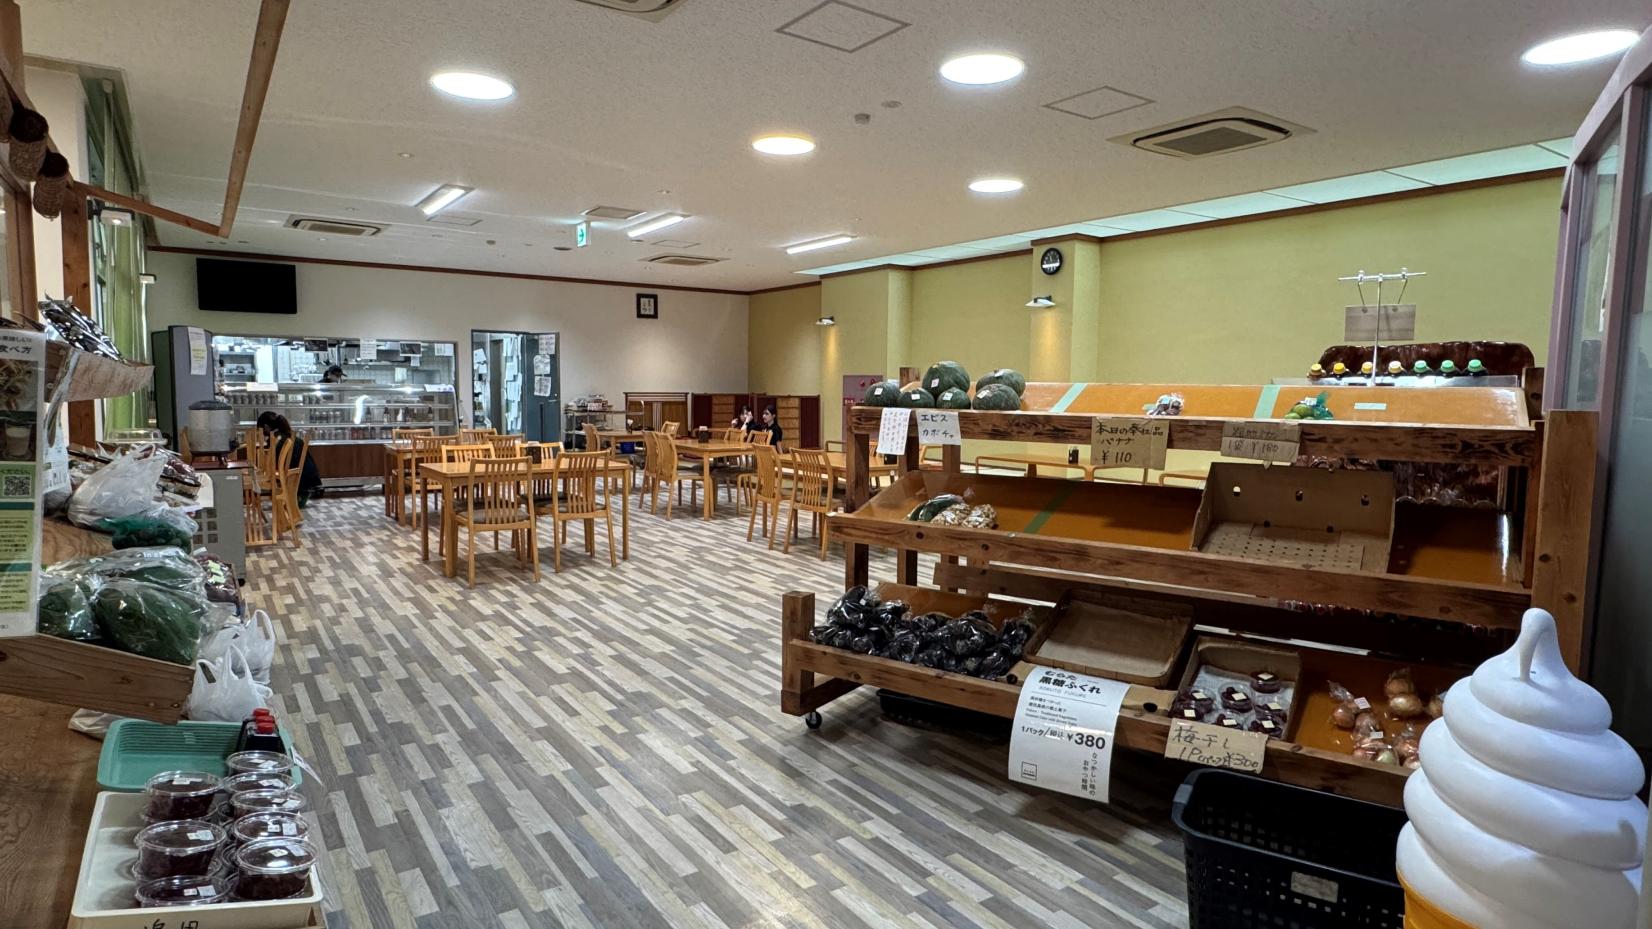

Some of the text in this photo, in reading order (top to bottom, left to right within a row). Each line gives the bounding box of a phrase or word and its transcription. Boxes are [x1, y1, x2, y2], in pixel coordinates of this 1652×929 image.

[920, 414, 949, 423] エビス
[922, 429, 955, 440] カボチャ
[1100, 437, 1135, 445] バナナ
[1039, 675, 1101, 694] 黒糖ふくれ
[1067, 732, 1106, 750] ¥380
[1172, 725, 1231, 749] 梅干し
